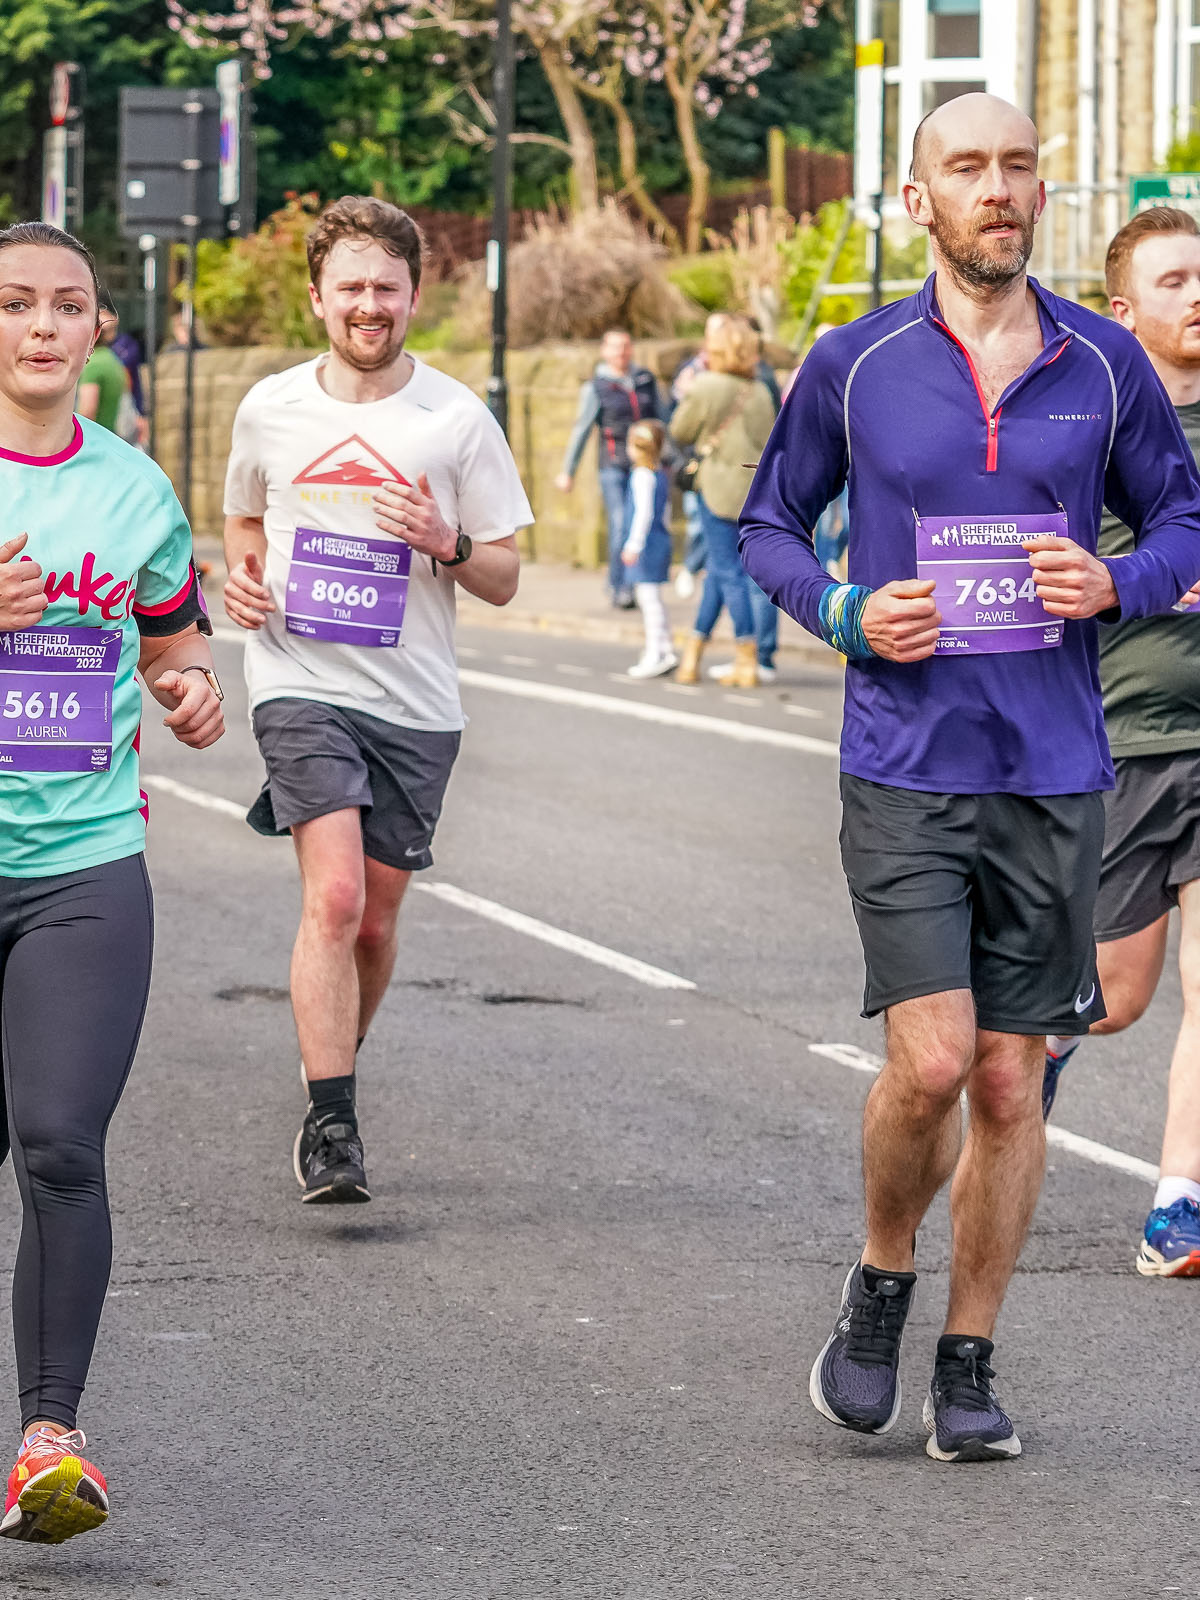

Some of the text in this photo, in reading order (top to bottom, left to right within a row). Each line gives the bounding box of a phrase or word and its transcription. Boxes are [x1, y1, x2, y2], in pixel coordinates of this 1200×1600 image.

[299, 490, 341, 504] NIKE
[962, 525, 1015, 534] SHEFFIELD
[325, 539, 366, 551] SHEFFIELD
[962, 534, 991, 545] HALF
[346, 551, 399, 563] MARATHON
[373, 562, 398, 573] 2022
[311, 579, 379, 609] 8060
[955, 577, 1038, 606] 7634
[332, 607, 352, 620] TIM
[975, 610, 1019, 623] PAWEL
[15, 633, 68, 645] SHEFFIELD
[956, 640, 970, 648] ALL
[14, 644, 105, 657] HALF MARATHON
[75, 658, 103, 669] 2022
[2, 690, 81, 720] 5616
[16, 725, 67, 738] LAUREN
[0, 755, 14, 763] ALL
